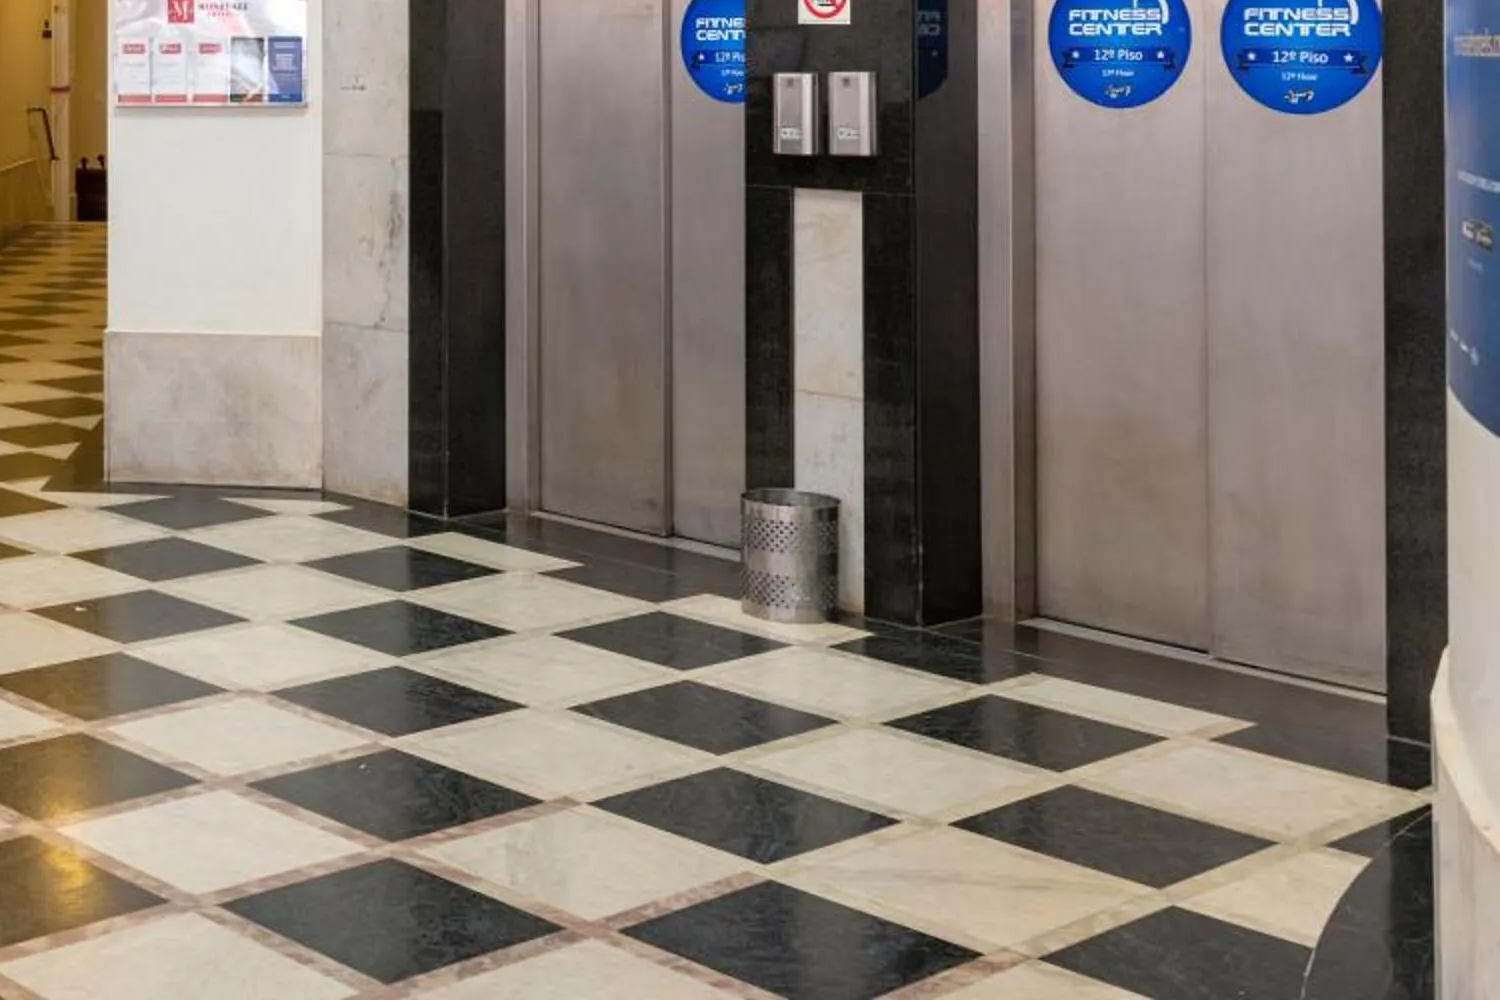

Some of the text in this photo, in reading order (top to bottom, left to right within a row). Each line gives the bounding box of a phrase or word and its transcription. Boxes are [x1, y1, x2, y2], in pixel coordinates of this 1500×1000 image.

[1069, 9, 1161, 21] FITNESS
[1244, 7, 1350, 21] FITNESS
[696, 17, 745, 28] FITNE
[696, 29, 745, 41] CENT
[1069, 23, 1163, 36] CENTER
[1244, 23, 1351, 37] CENTER
[1118, 49, 1143, 61] Piso
[1300, 51, 1329, 64] Piso
